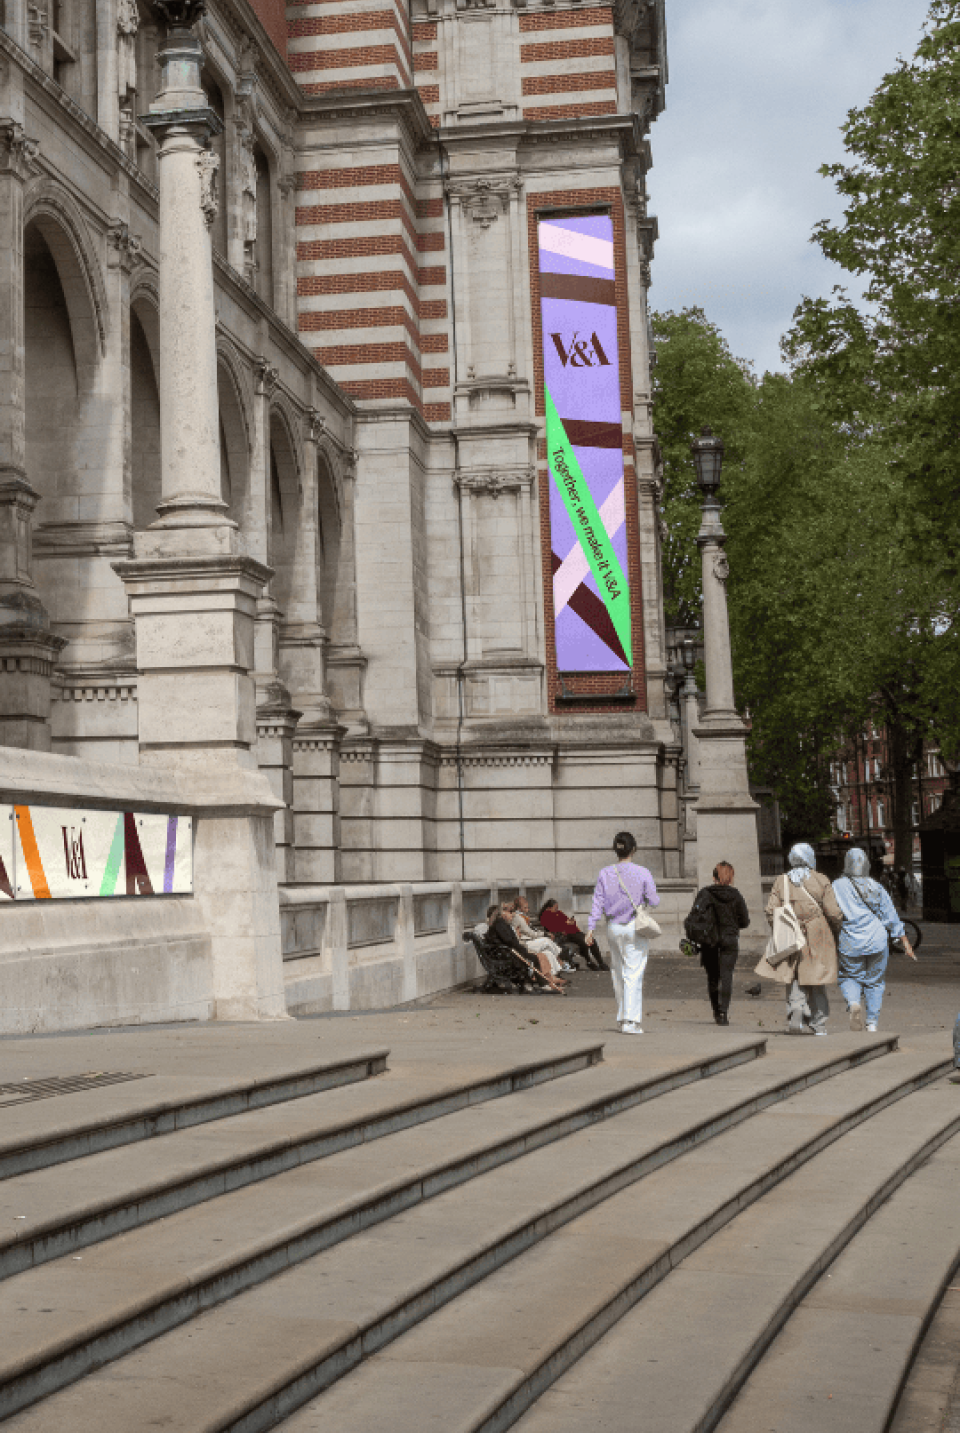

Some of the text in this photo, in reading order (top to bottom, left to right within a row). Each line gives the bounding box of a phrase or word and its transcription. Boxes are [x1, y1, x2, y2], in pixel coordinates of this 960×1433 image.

[548, 331, 614, 368] V&A
[553, 446, 621, 601] Together, we make it V&A
[60, 825, 89, 879] V&A
